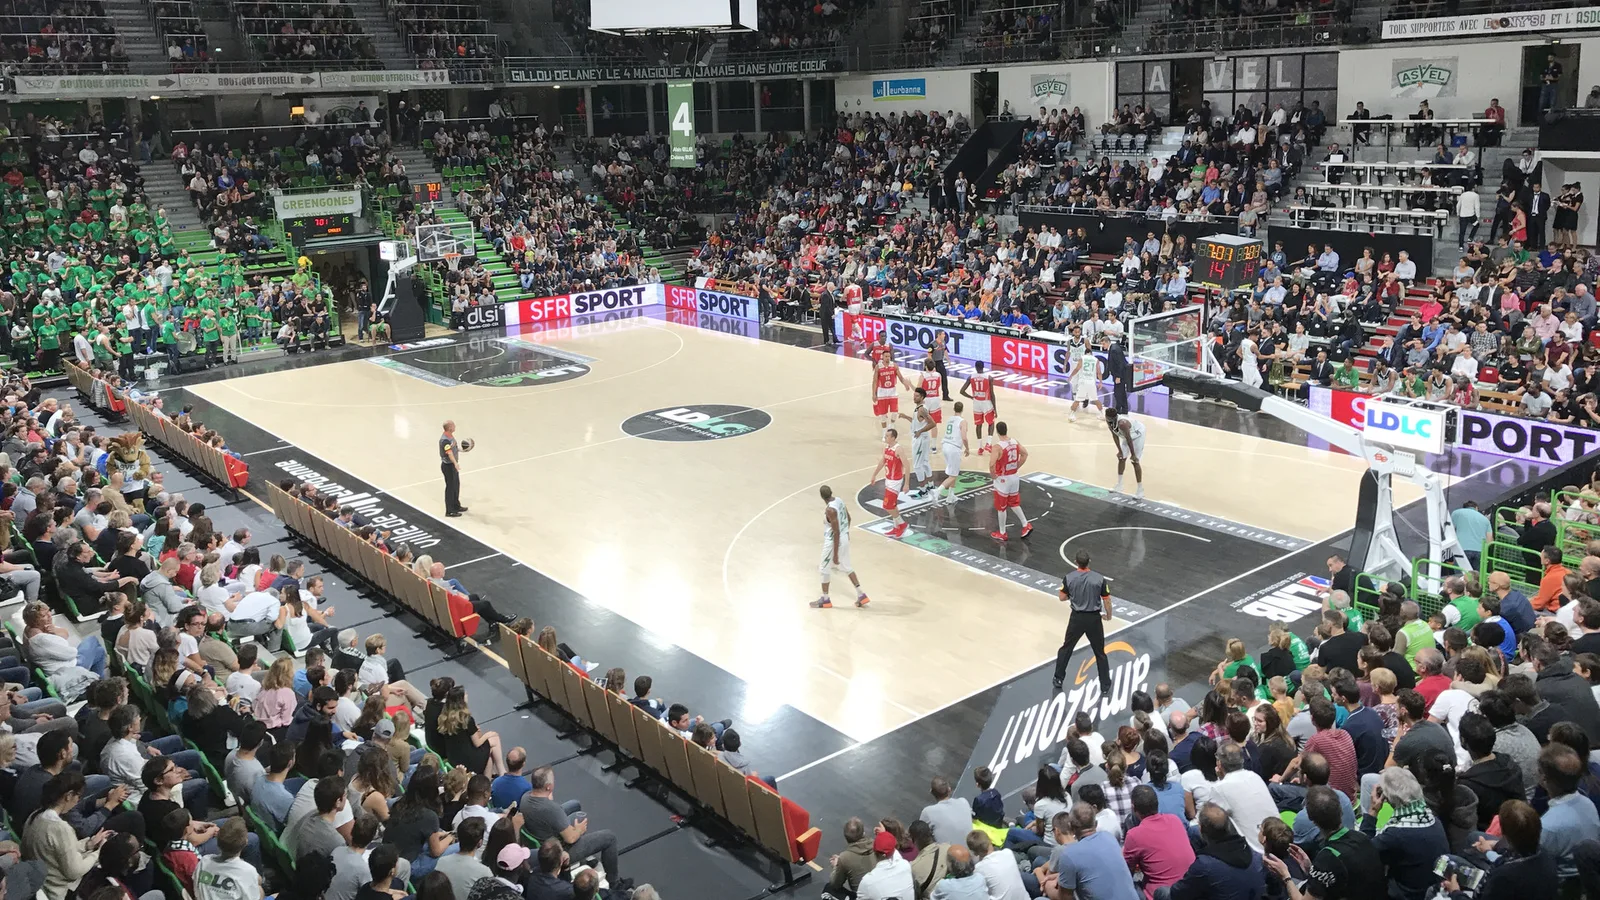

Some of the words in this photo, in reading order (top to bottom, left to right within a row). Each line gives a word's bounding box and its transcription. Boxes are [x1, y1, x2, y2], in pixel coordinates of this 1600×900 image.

[1389, 24, 1407, 35] TOUS
[1410, 20, 1455, 34] SUPPORTERS
[1459, 18, 1479, 31] AVEC
[1550, 13, 1563, 25] ET
[218, 76, 256, 87] BOUTIQUE
[257, 76, 295, 85] OFFICIELLE
[351, 73, 385, 83] BOUTIQUE
[386, 72, 420, 82] OFFICIELLE
[511, 70, 552, 82] GILLOU
[554, 69, 603, 81] DELANEY
[606, 68, 621, 79] LE
[623, 68, 631, 79] 4
[634, 67, 681, 79] MAGIQUE
[685, 67, 692, 77] A
[695, 65, 736, 78] JAMAIS
[738, 63, 766, 75] DANS
[768, 61, 799, 73] NOTRE
[800, 60, 828, 72] COEUR
[1402, 64, 1445, 82] ASVEL
[60, 79, 104, 89] BOUTIQUE
[105, 77, 149, 88] OFFICIELLE
[876, 81, 921, 97] villeurbanne
[1037, 79, 1064, 93] ASVEL
[672, 102, 693, 137] 4
[282, 195, 355, 210] GREENGONES
[530, 298, 569, 321] SFR
[575, 287, 646, 314] SPORT
[672, 289, 696, 309] SFR
[699, 291, 750, 317] SPORT
[467, 305, 499, 325] dlsi
[1003, 340, 1046, 371] SFR
[975, 381, 984, 391] 11
[946, 423, 953, 435] 9
[1367, 408, 1432, 439] LDLC
[1462, 415, 1597, 462] PORT
[1028, 473, 1110, 500] LDLC
[1111, 495, 1192, 520] HIGH-TECH
[1197, 517, 1299, 549] EXPERIENCE
[390, 525, 442, 549] ville
[951, 550, 1031, 581] HIGH-TECH
[1242, 582, 1331, 623] LNB
